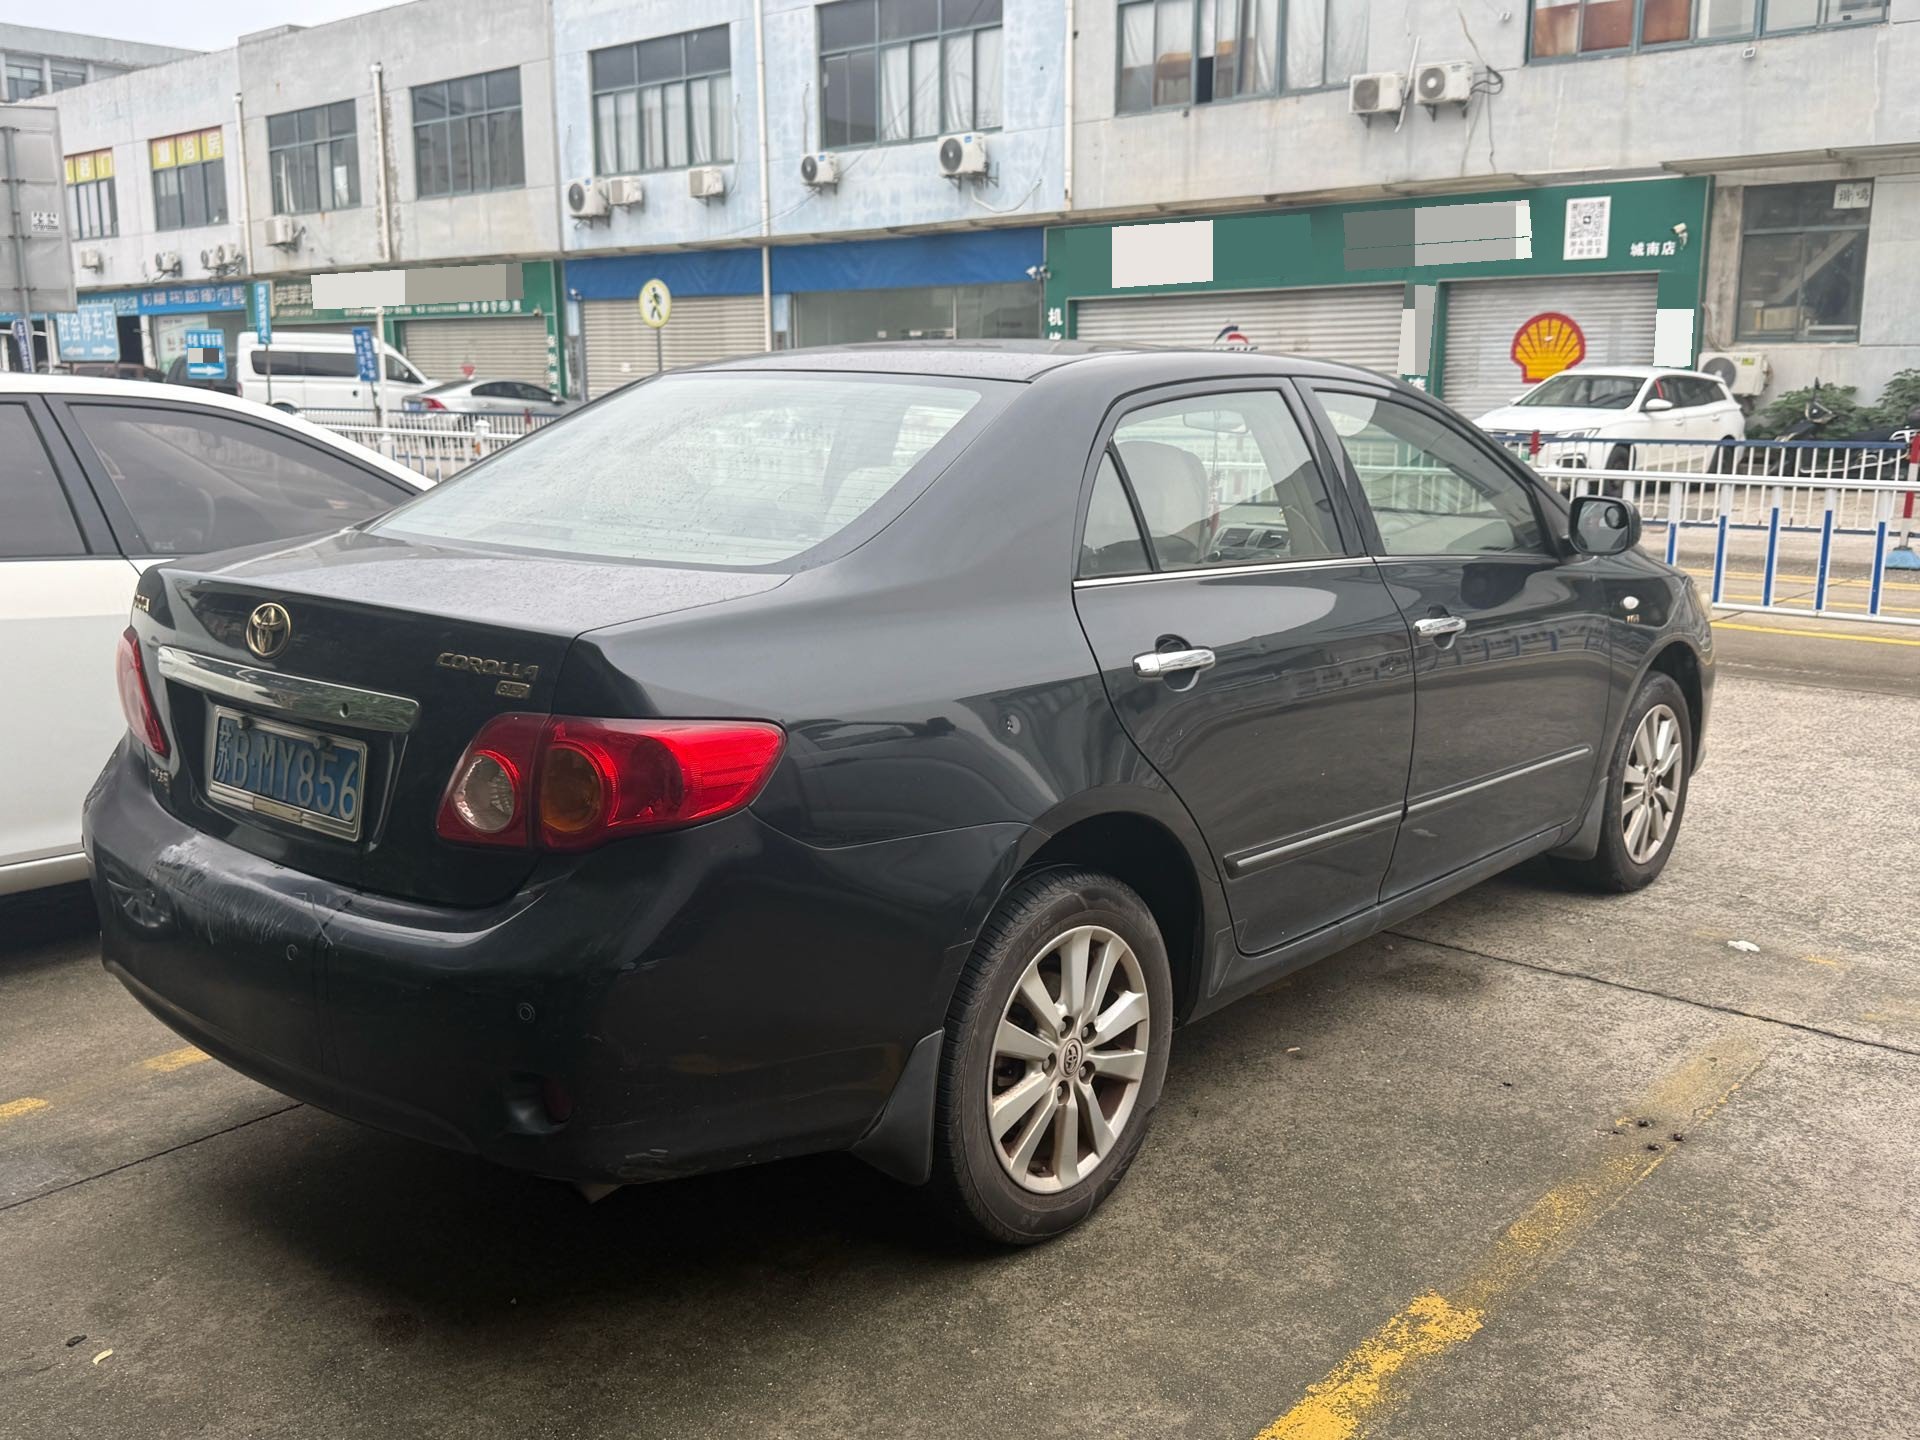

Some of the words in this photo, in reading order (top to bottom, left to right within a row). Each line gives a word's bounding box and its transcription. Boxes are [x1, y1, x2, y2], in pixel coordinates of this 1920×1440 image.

[1629, 241, 1677, 257] 城南店
[58, 309, 116, 341] 社会停车区
[437, 652, 539, 682] COROLLA
